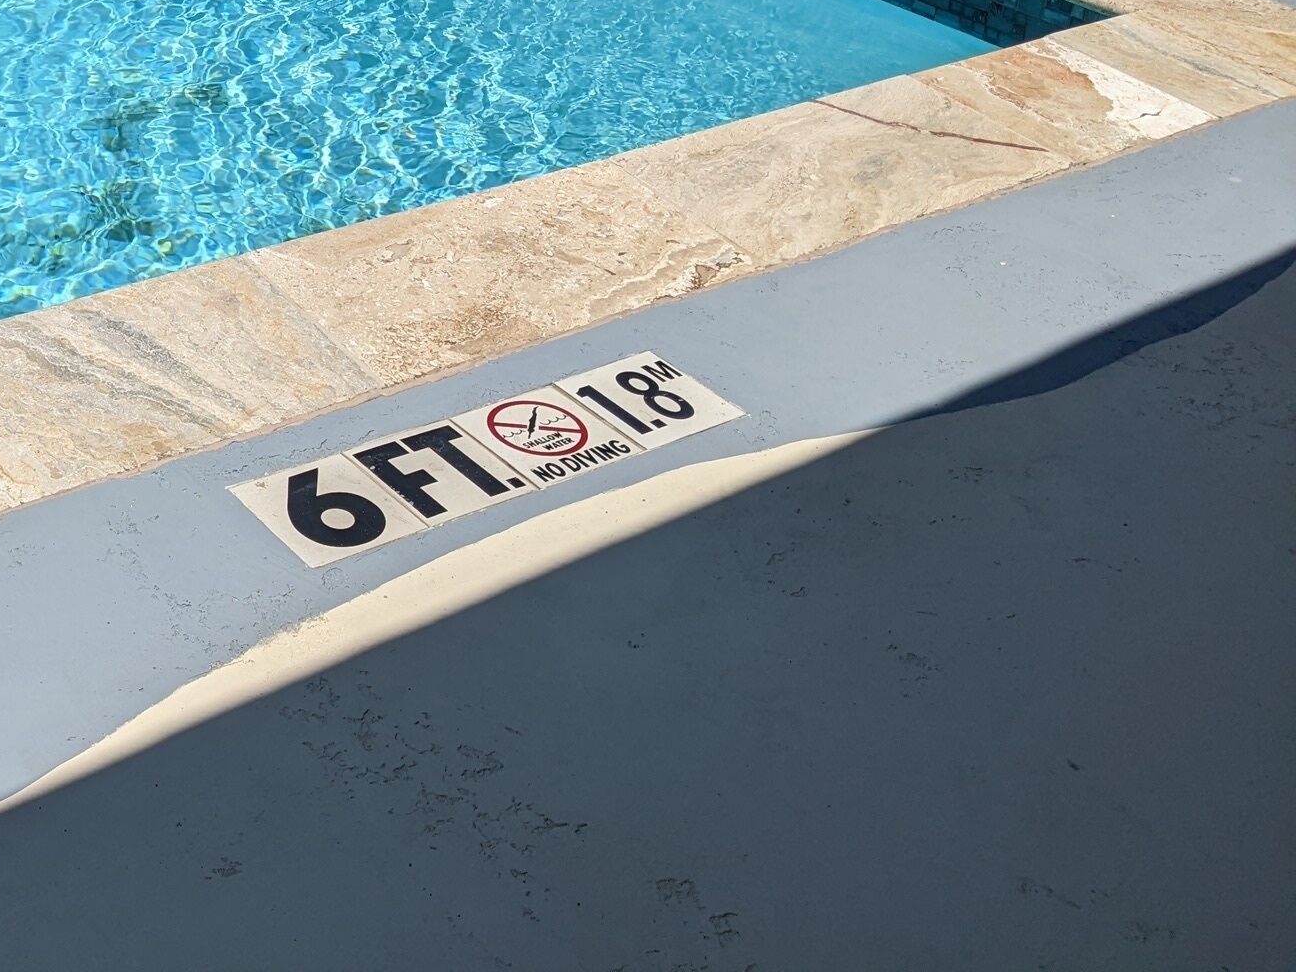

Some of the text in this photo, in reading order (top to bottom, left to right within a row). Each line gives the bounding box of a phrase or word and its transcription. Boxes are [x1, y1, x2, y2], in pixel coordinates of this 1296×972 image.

[522, 431, 563, 449] SHALLOW
[542, 437, 575, 451] WATER
[531, 439, 631, 482] NO DIVING
[287, 468, 386, 547] 6
